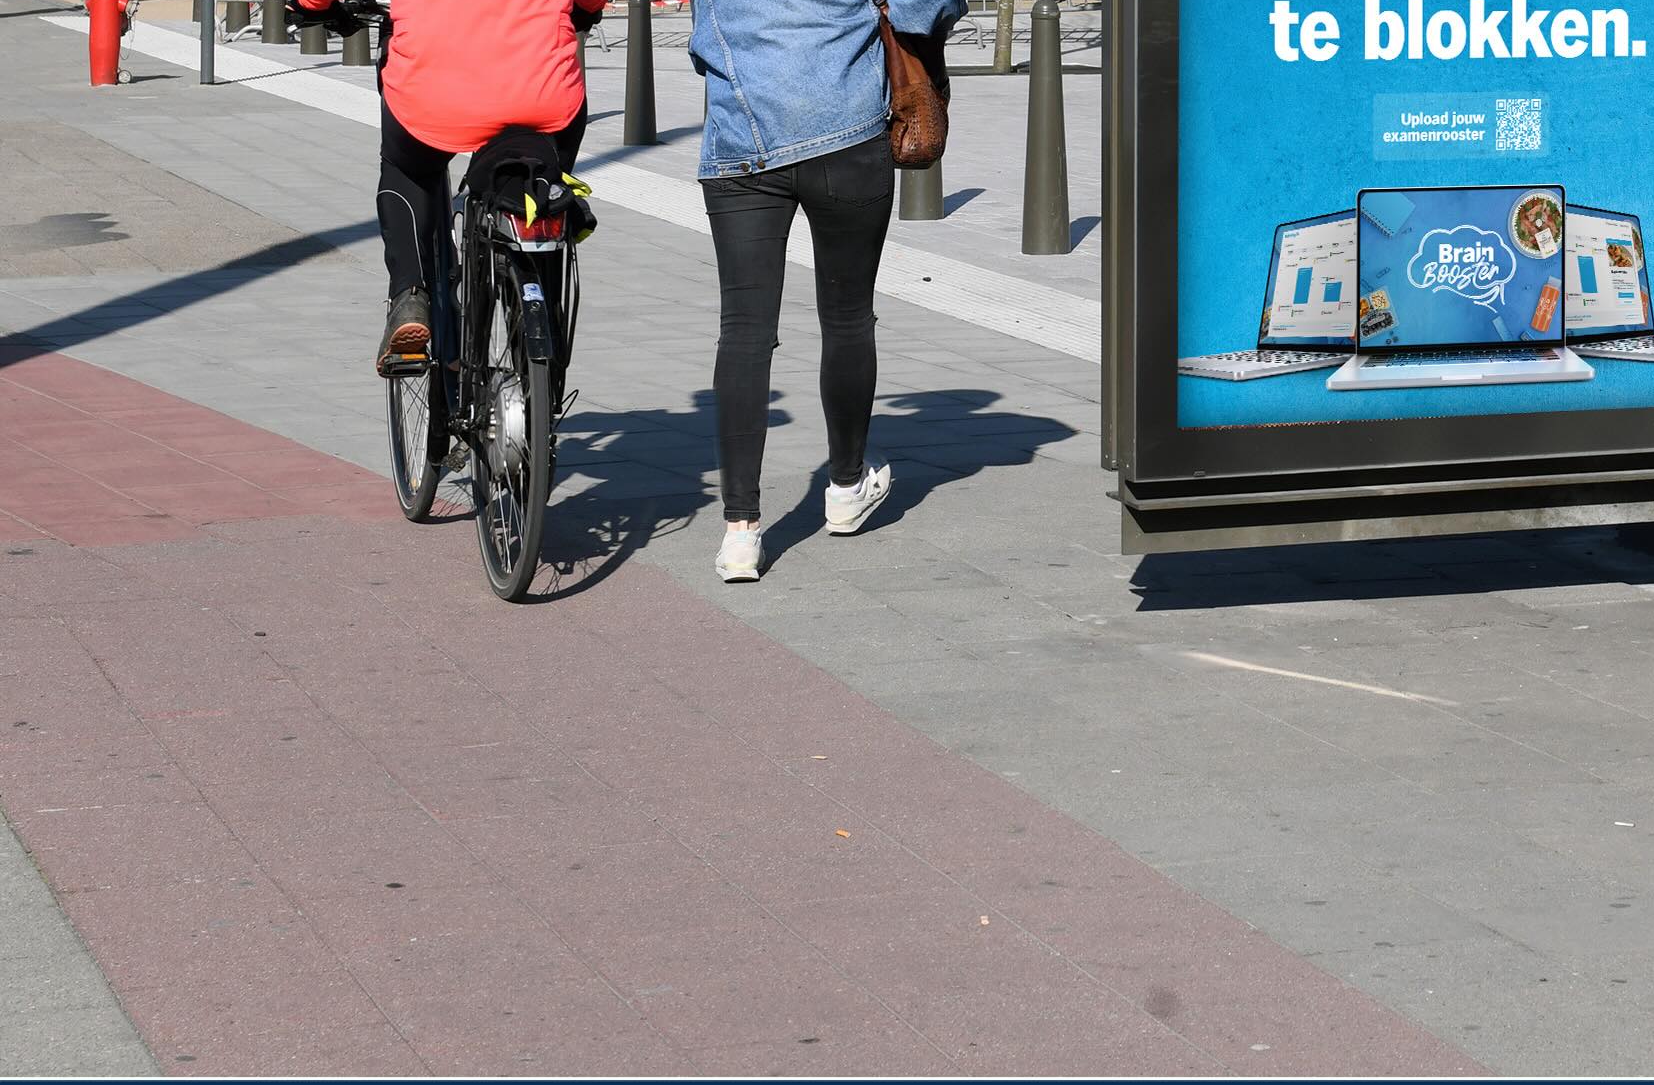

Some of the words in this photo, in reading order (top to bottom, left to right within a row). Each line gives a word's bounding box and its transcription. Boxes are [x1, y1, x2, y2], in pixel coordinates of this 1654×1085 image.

[1269, 0, 1341, 63] te
[1401, 112, 1449, 128] Upload
[1451, 112, 1486, 128] jouw
[1383, 128, 1486, 143] examenrooster
[1439, 241, 1494, 264] Brain
